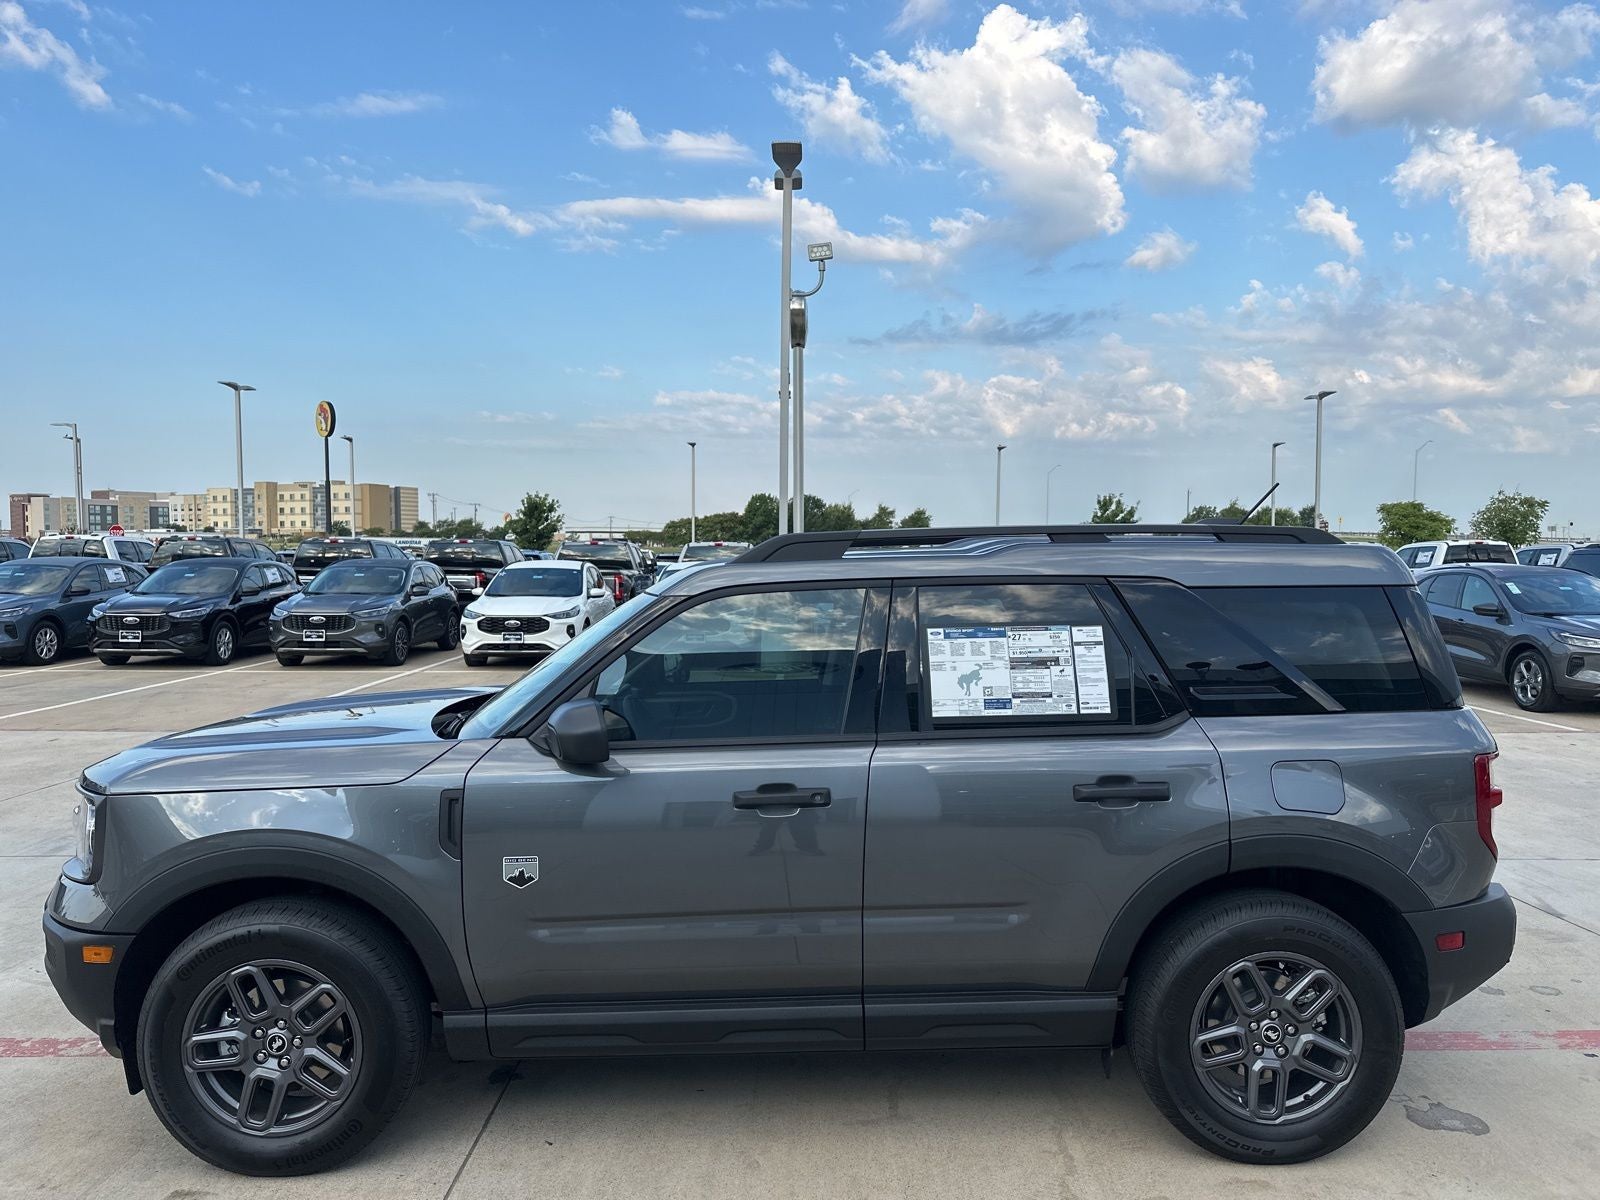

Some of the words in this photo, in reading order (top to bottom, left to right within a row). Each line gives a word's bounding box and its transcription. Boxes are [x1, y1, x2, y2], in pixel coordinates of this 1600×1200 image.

[110, 529, 124, 537] STOP
[1011, 633, 1022, 641] 27
[176, 930, 252, 981] Continental
[286, 1118, 364, 1169] Continental
